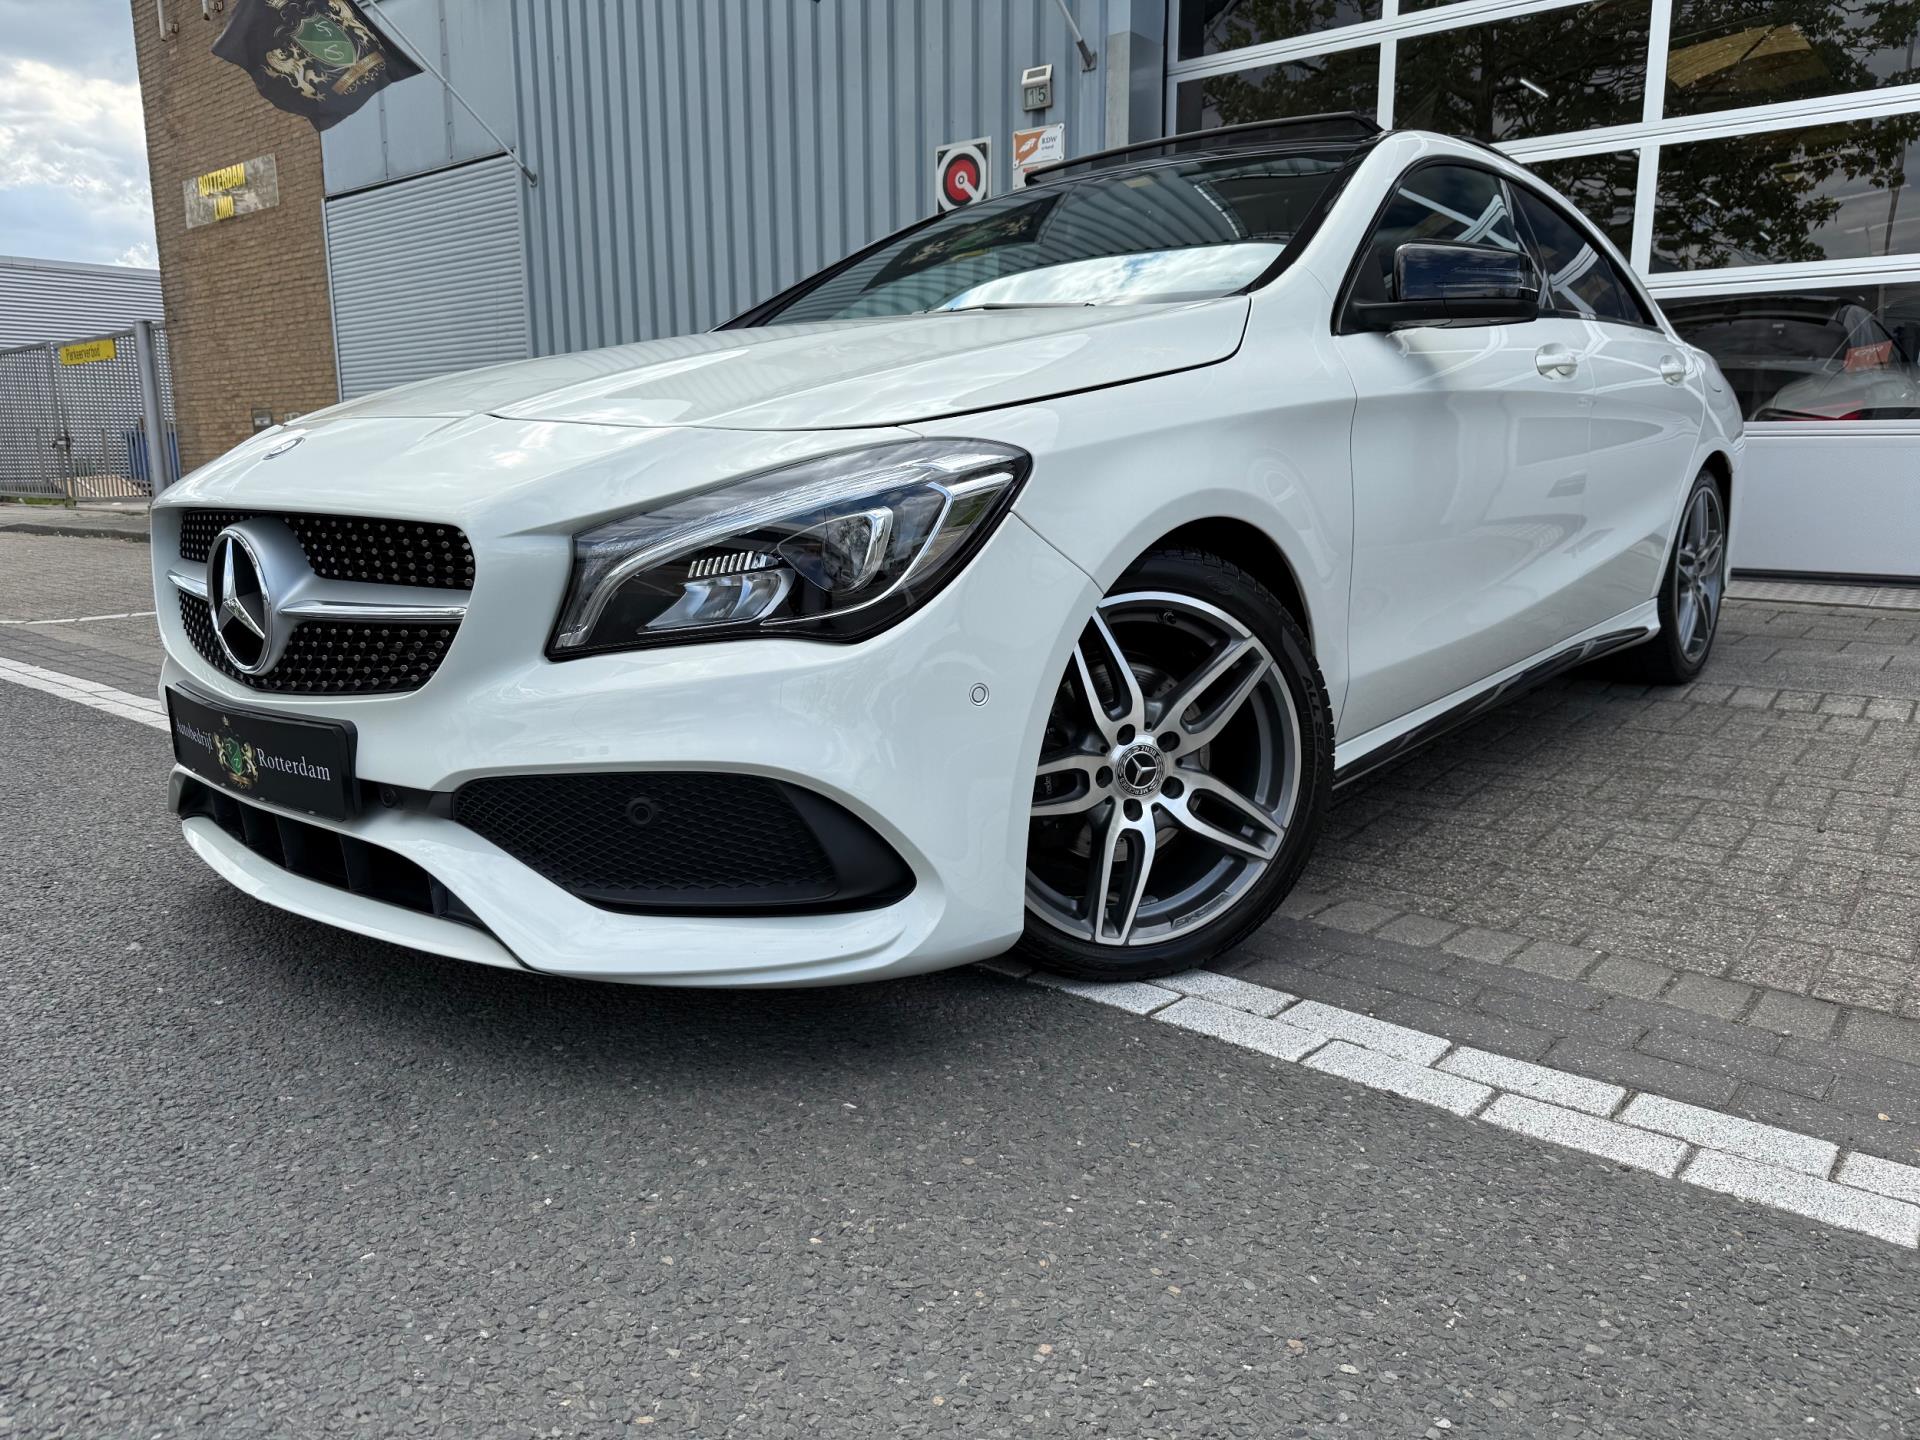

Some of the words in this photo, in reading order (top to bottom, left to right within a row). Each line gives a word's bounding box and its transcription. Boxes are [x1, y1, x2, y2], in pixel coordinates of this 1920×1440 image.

[1029, 86, 1046, 103] 15
[1041, 136, 1058, 144] RDW
[198, 162, 246, 198] ROTTERDAM
[214, 195, 234, 221] LIMO
[65, 343, 101, 361] Parkeerverbod
[176, 716, 213, 754] Autobedrijf
[256, 747, 331, 781] Rotterdam
